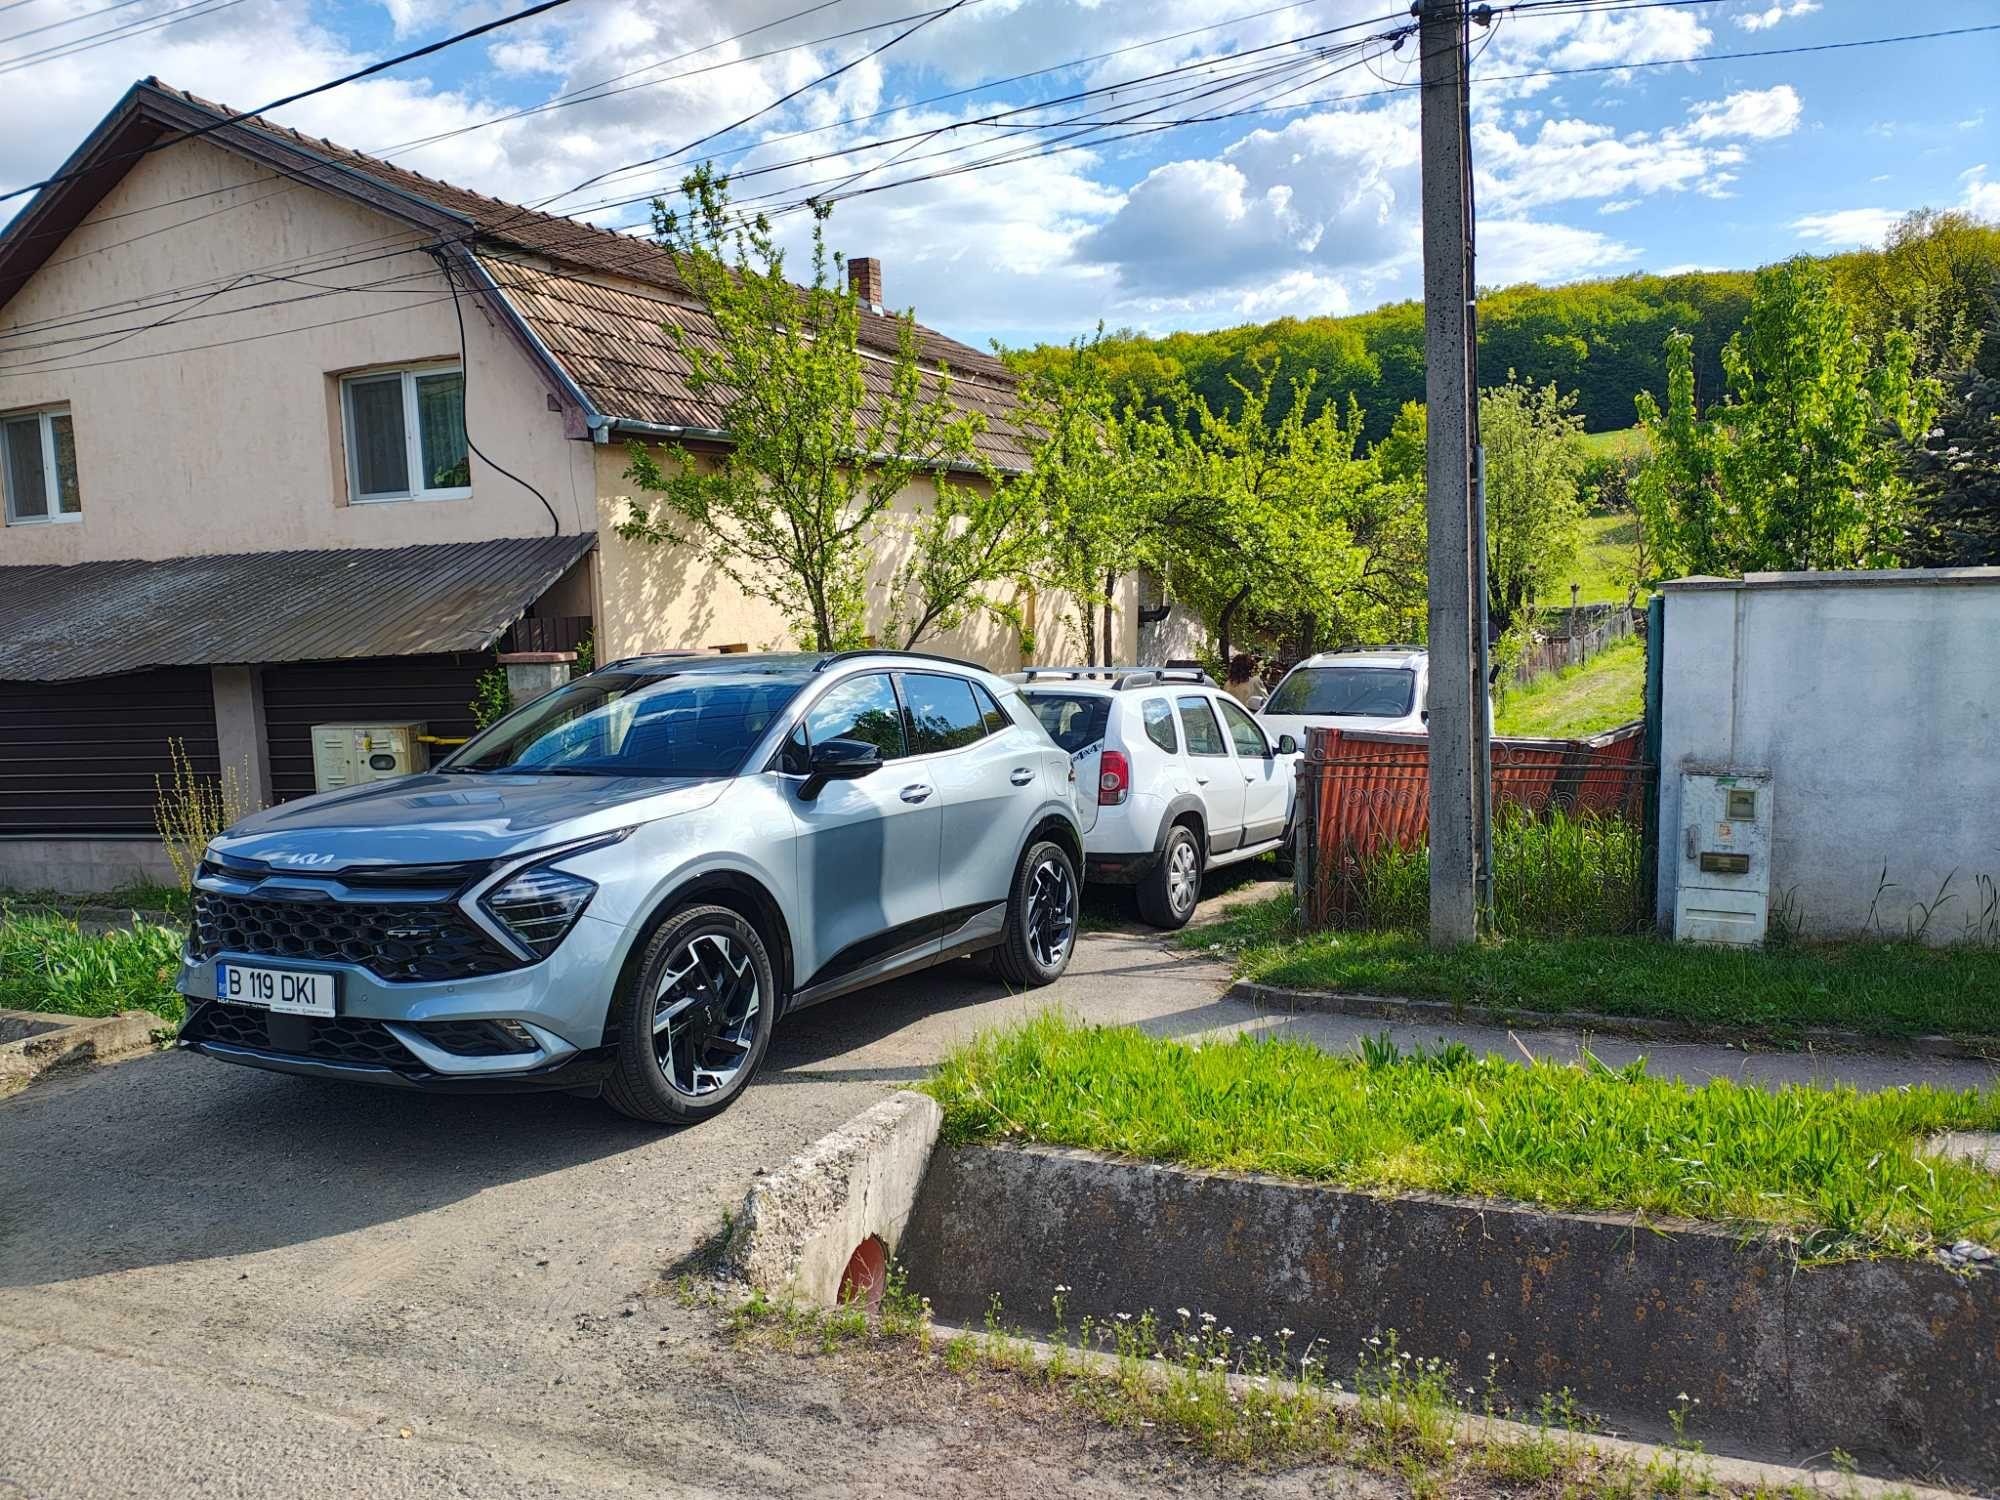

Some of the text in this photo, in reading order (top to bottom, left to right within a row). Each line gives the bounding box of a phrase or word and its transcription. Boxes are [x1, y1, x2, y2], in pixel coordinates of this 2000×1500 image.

[288, 852, 335, 865] KIA
[229, 969, 241, 995] B
[250, 972, 273, 999] 119
[281, 975, 316, 1004] DKI
